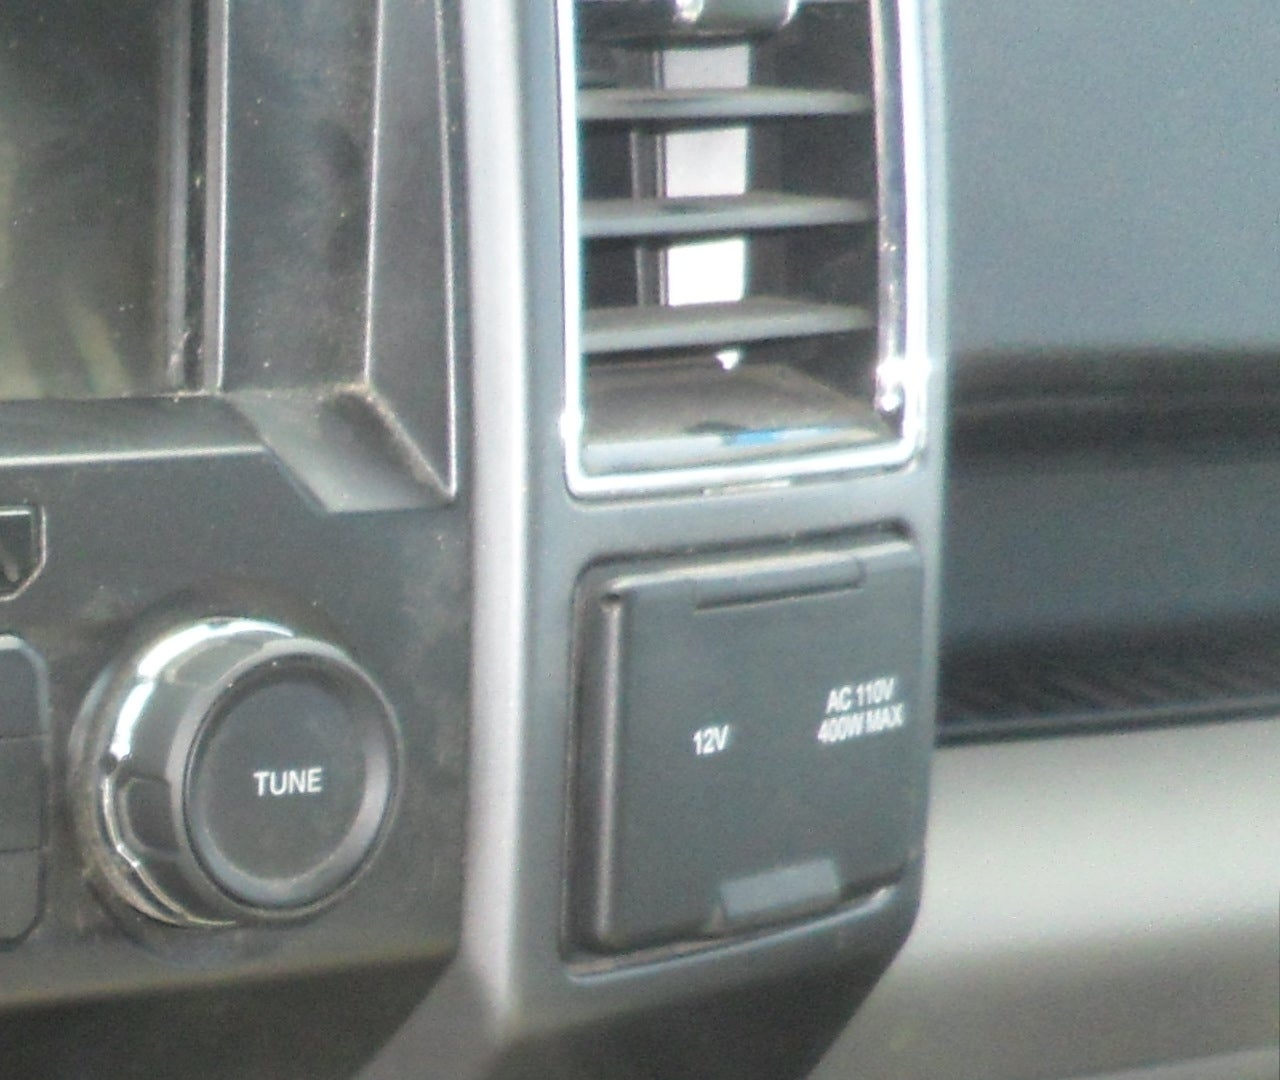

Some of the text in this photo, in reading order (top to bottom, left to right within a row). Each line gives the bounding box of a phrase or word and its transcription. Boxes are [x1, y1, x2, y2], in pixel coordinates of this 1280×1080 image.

[825, 678, 895, 714] AC 110V
[817, 703, 905, 743] 400W MAX
[692, 725, 730, 755] 12V
[253, 767, 323, 797] TUNE
